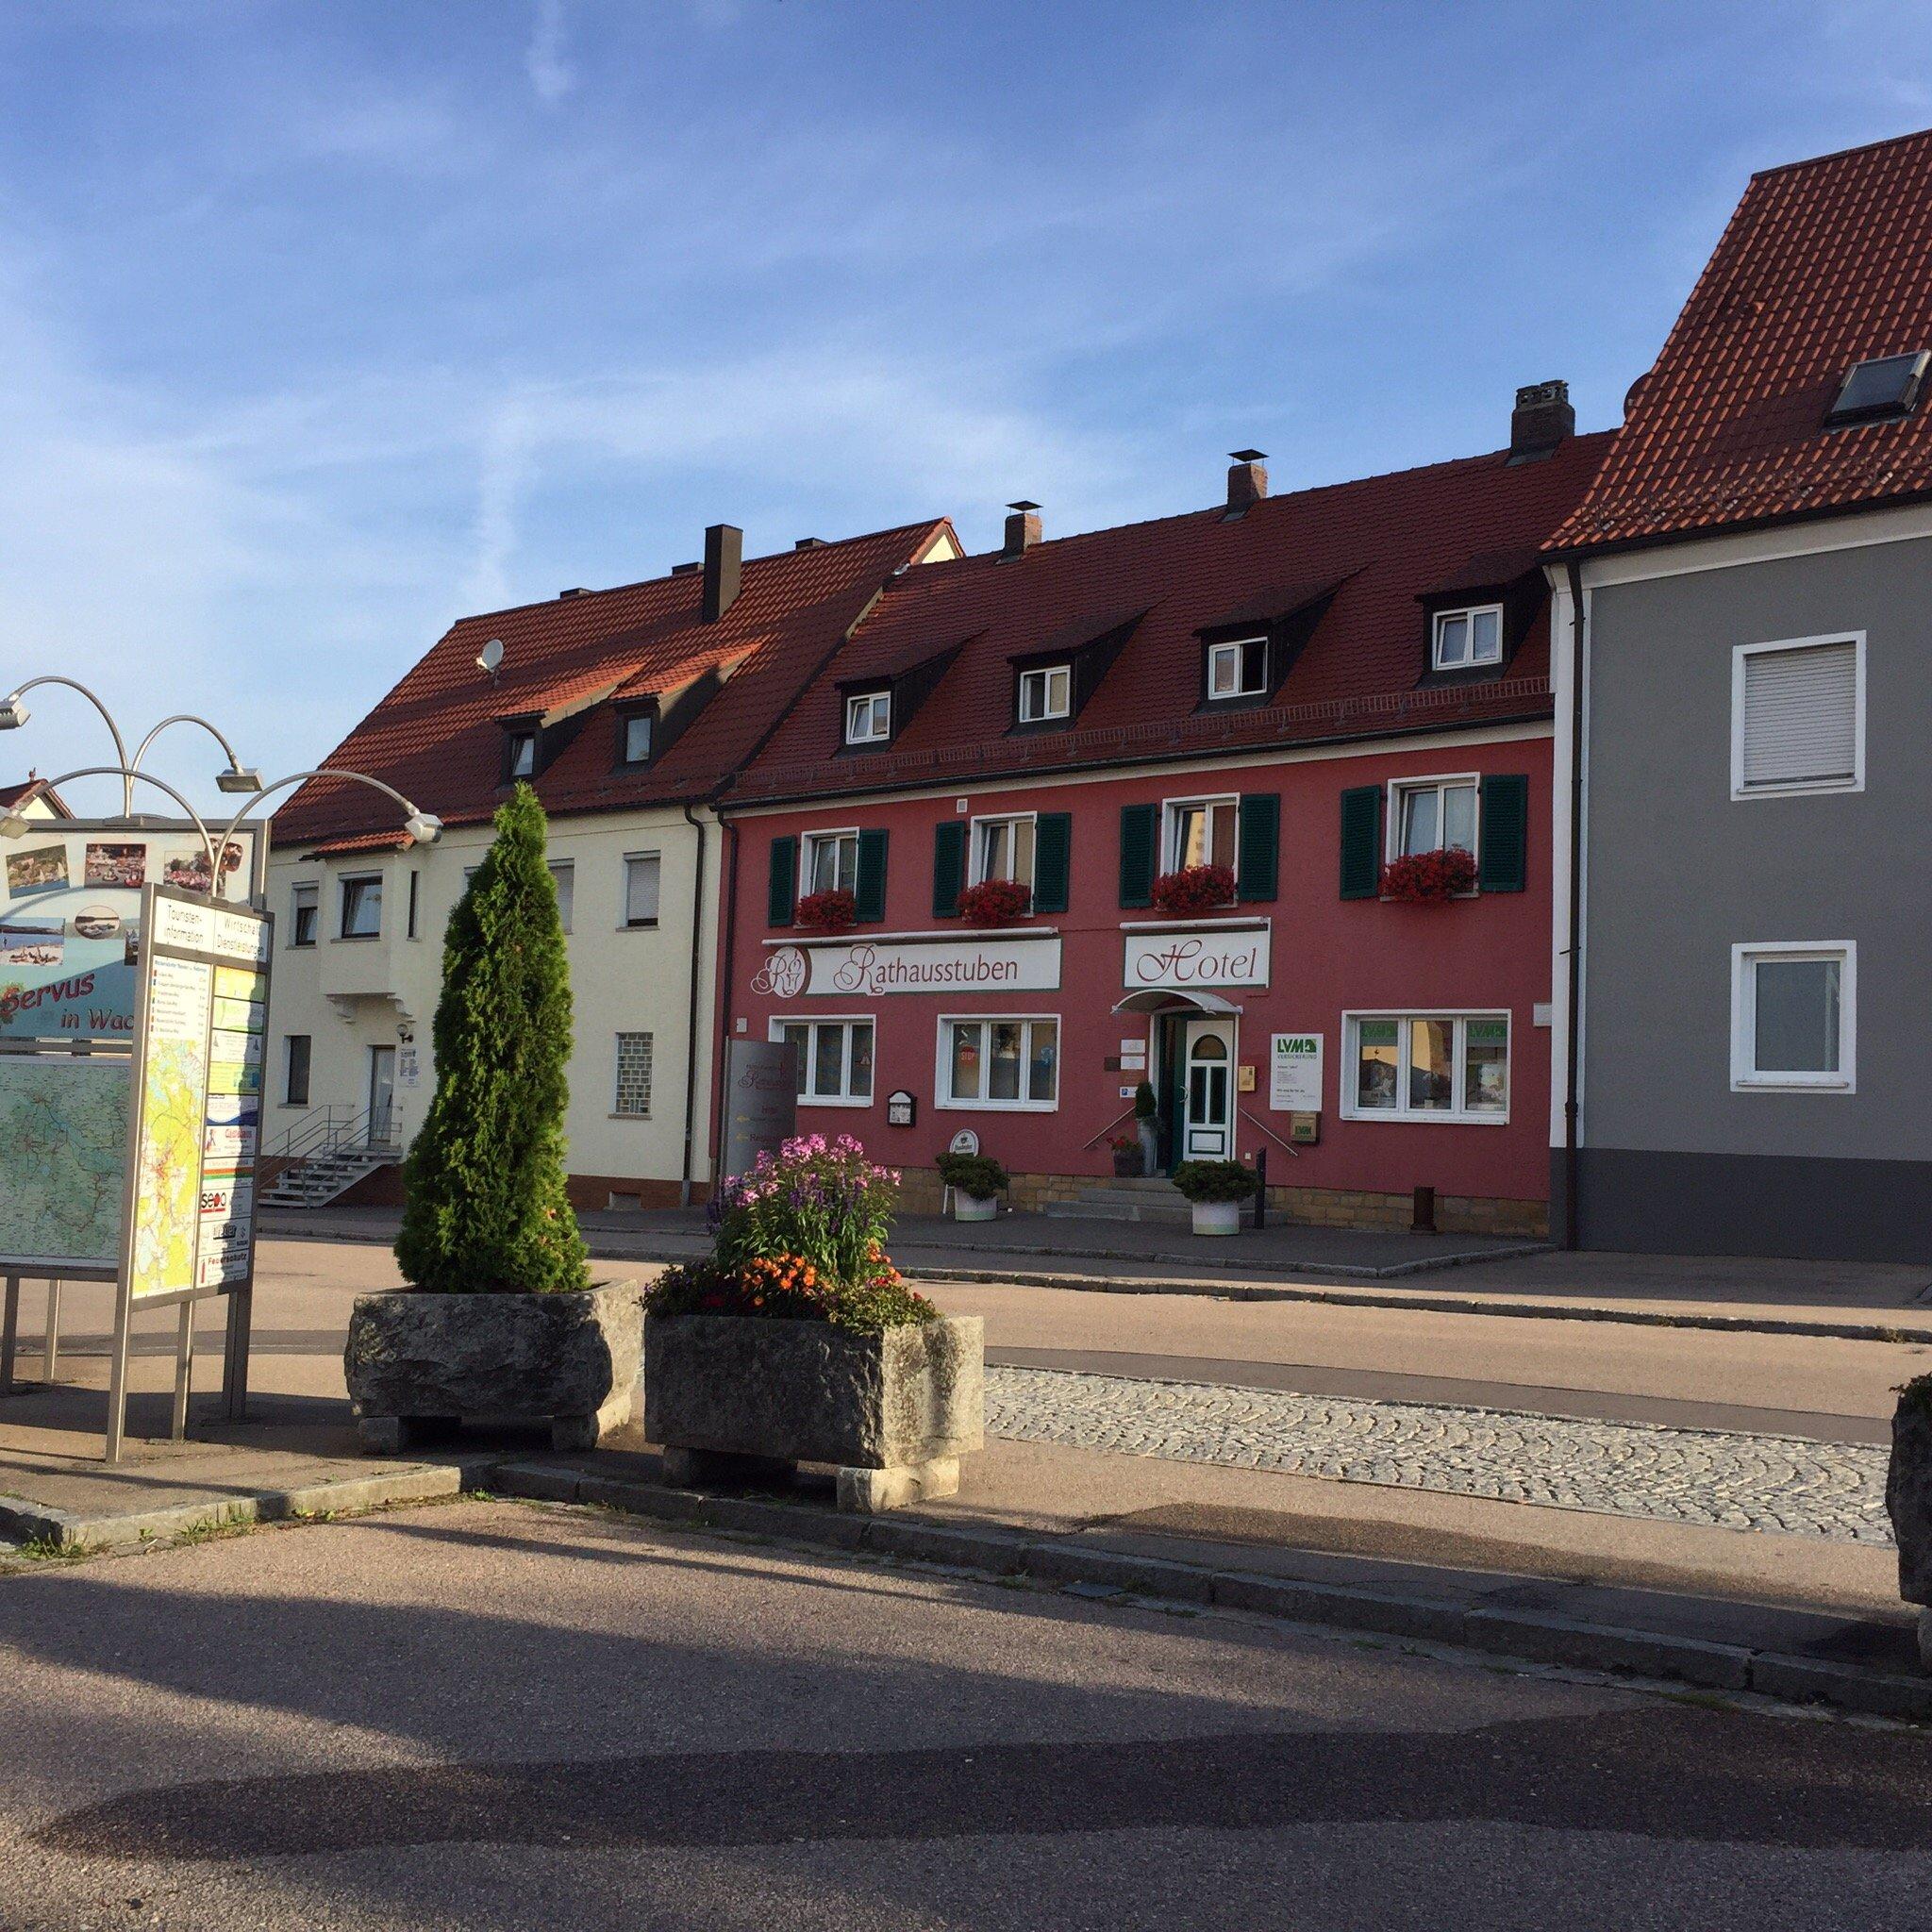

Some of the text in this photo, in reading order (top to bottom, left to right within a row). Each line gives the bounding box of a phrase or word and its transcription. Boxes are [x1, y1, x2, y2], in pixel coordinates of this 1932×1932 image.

[833, 943, 1018, 994] Rathausstuben
[1136, 939, 1257, 982] Hotel
[1, 973, 95, 1013] Servus
[60, 1008, 135, 1030] in Wac
[961, 1051, 975, 1060] STOP
[1277, 1039, 1304, 1053] LVM
